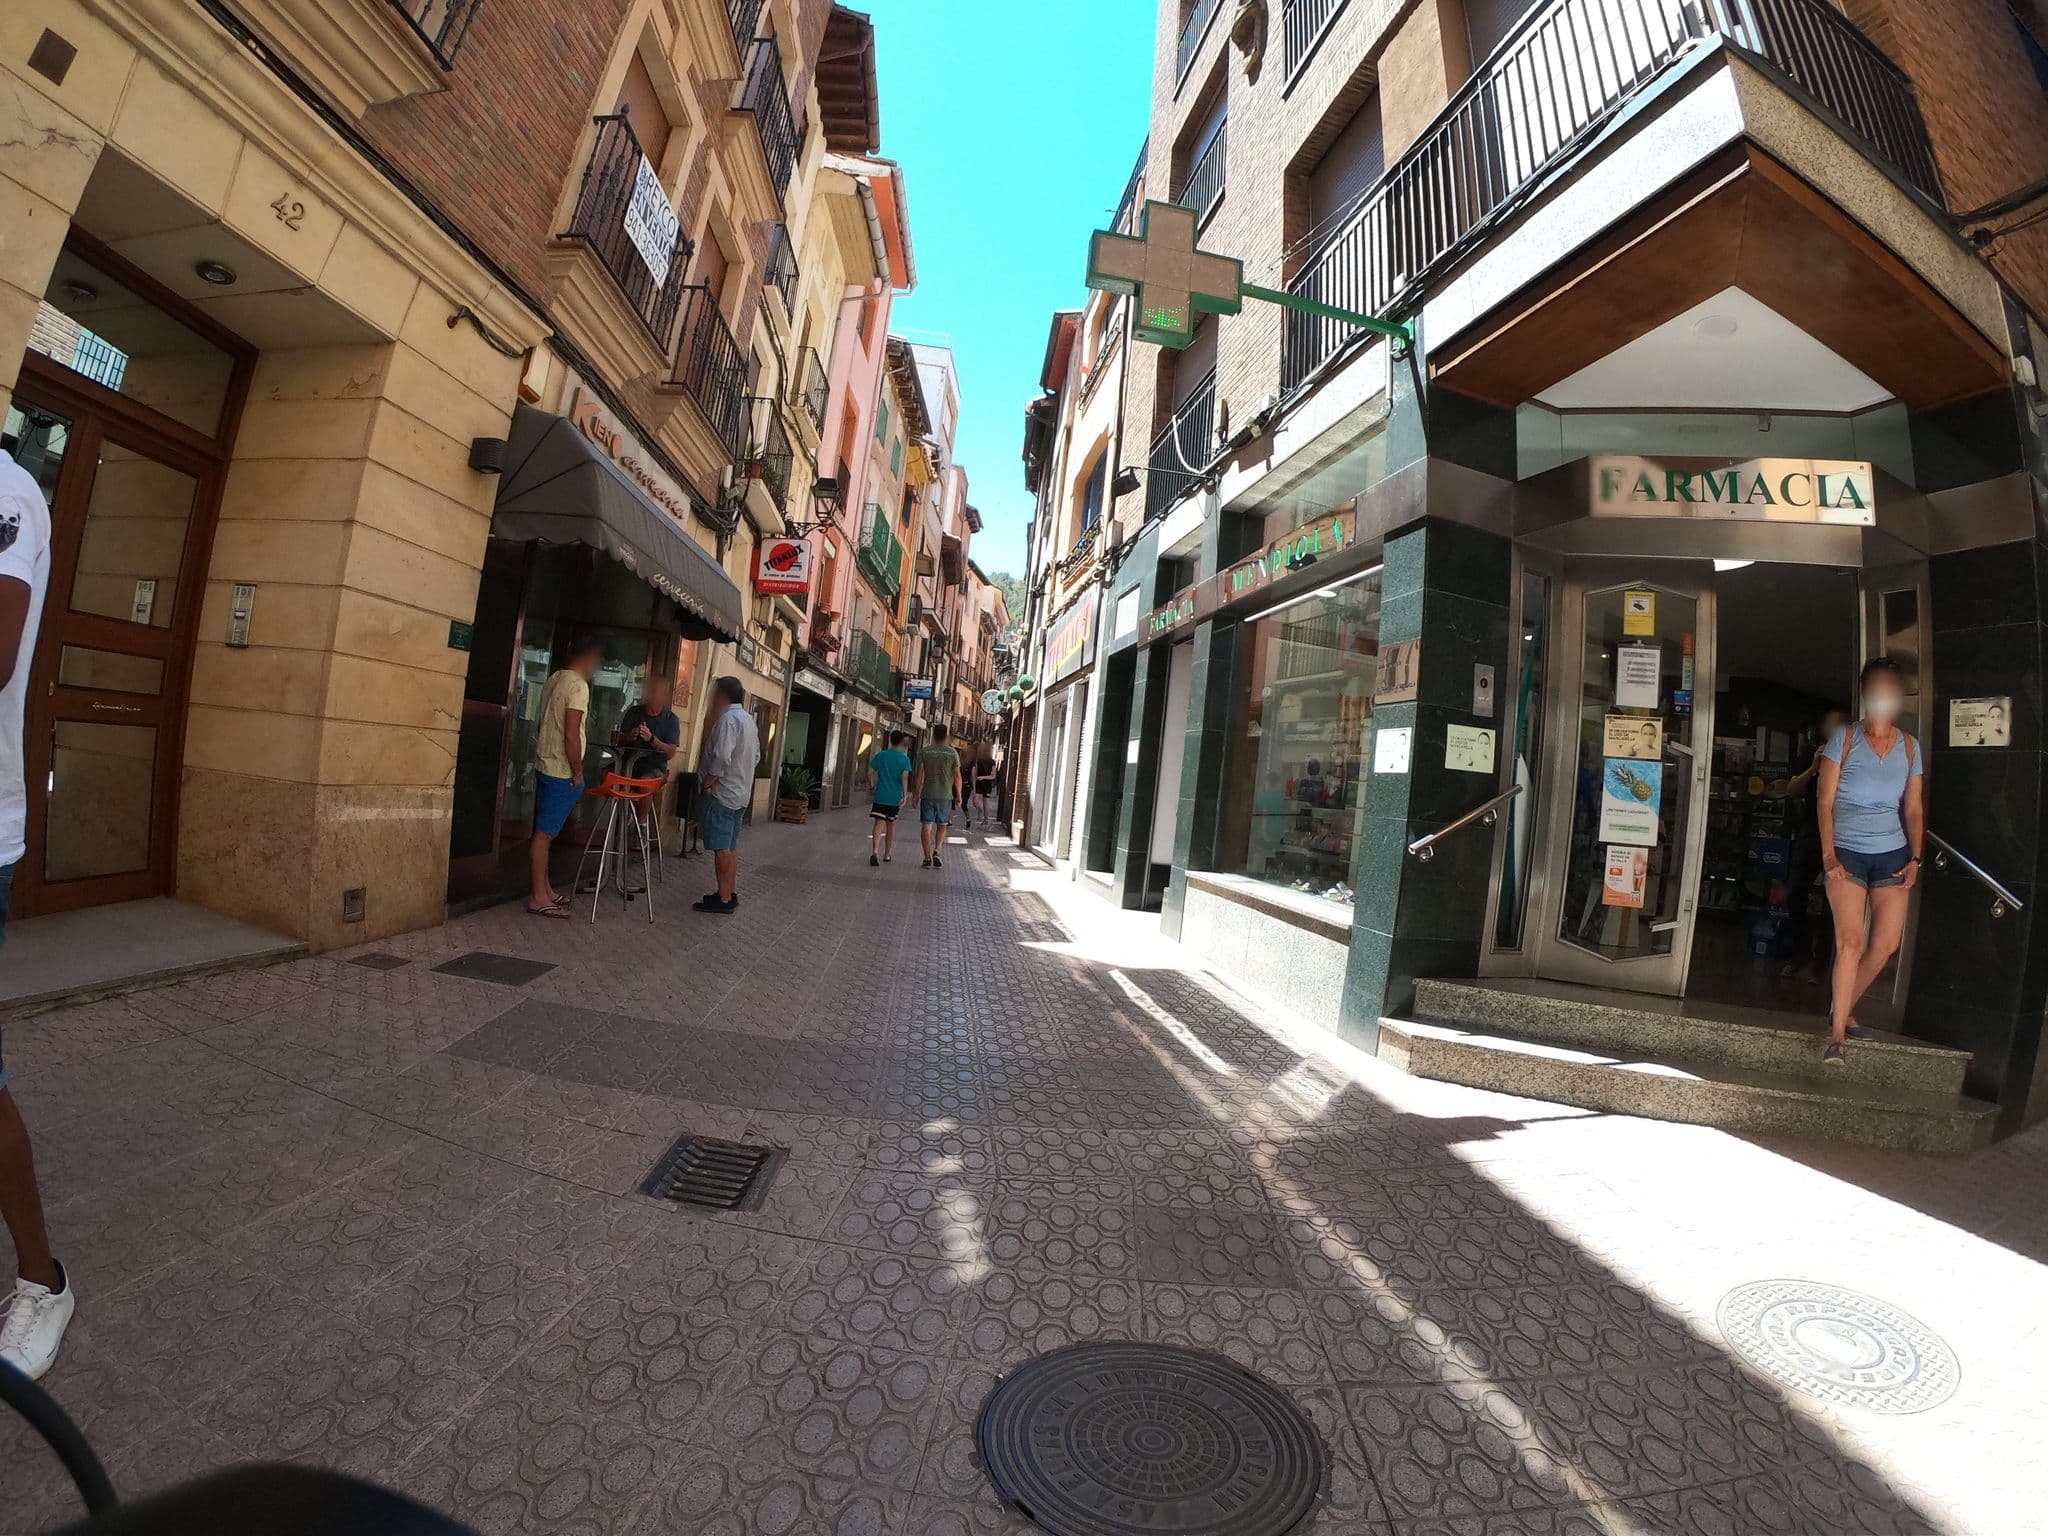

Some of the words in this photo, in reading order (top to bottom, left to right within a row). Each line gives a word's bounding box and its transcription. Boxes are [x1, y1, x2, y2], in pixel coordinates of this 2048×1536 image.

[270, 191, 304, 231] 42
[633, 186, 648, 219] EN
[644, 206, 671, 261] VENTA
[647, 174, 676, 238] REYCO
[1600, 468, 1868, 510] FARMACIA
[764, 544, 804, 571] TITANLUX
